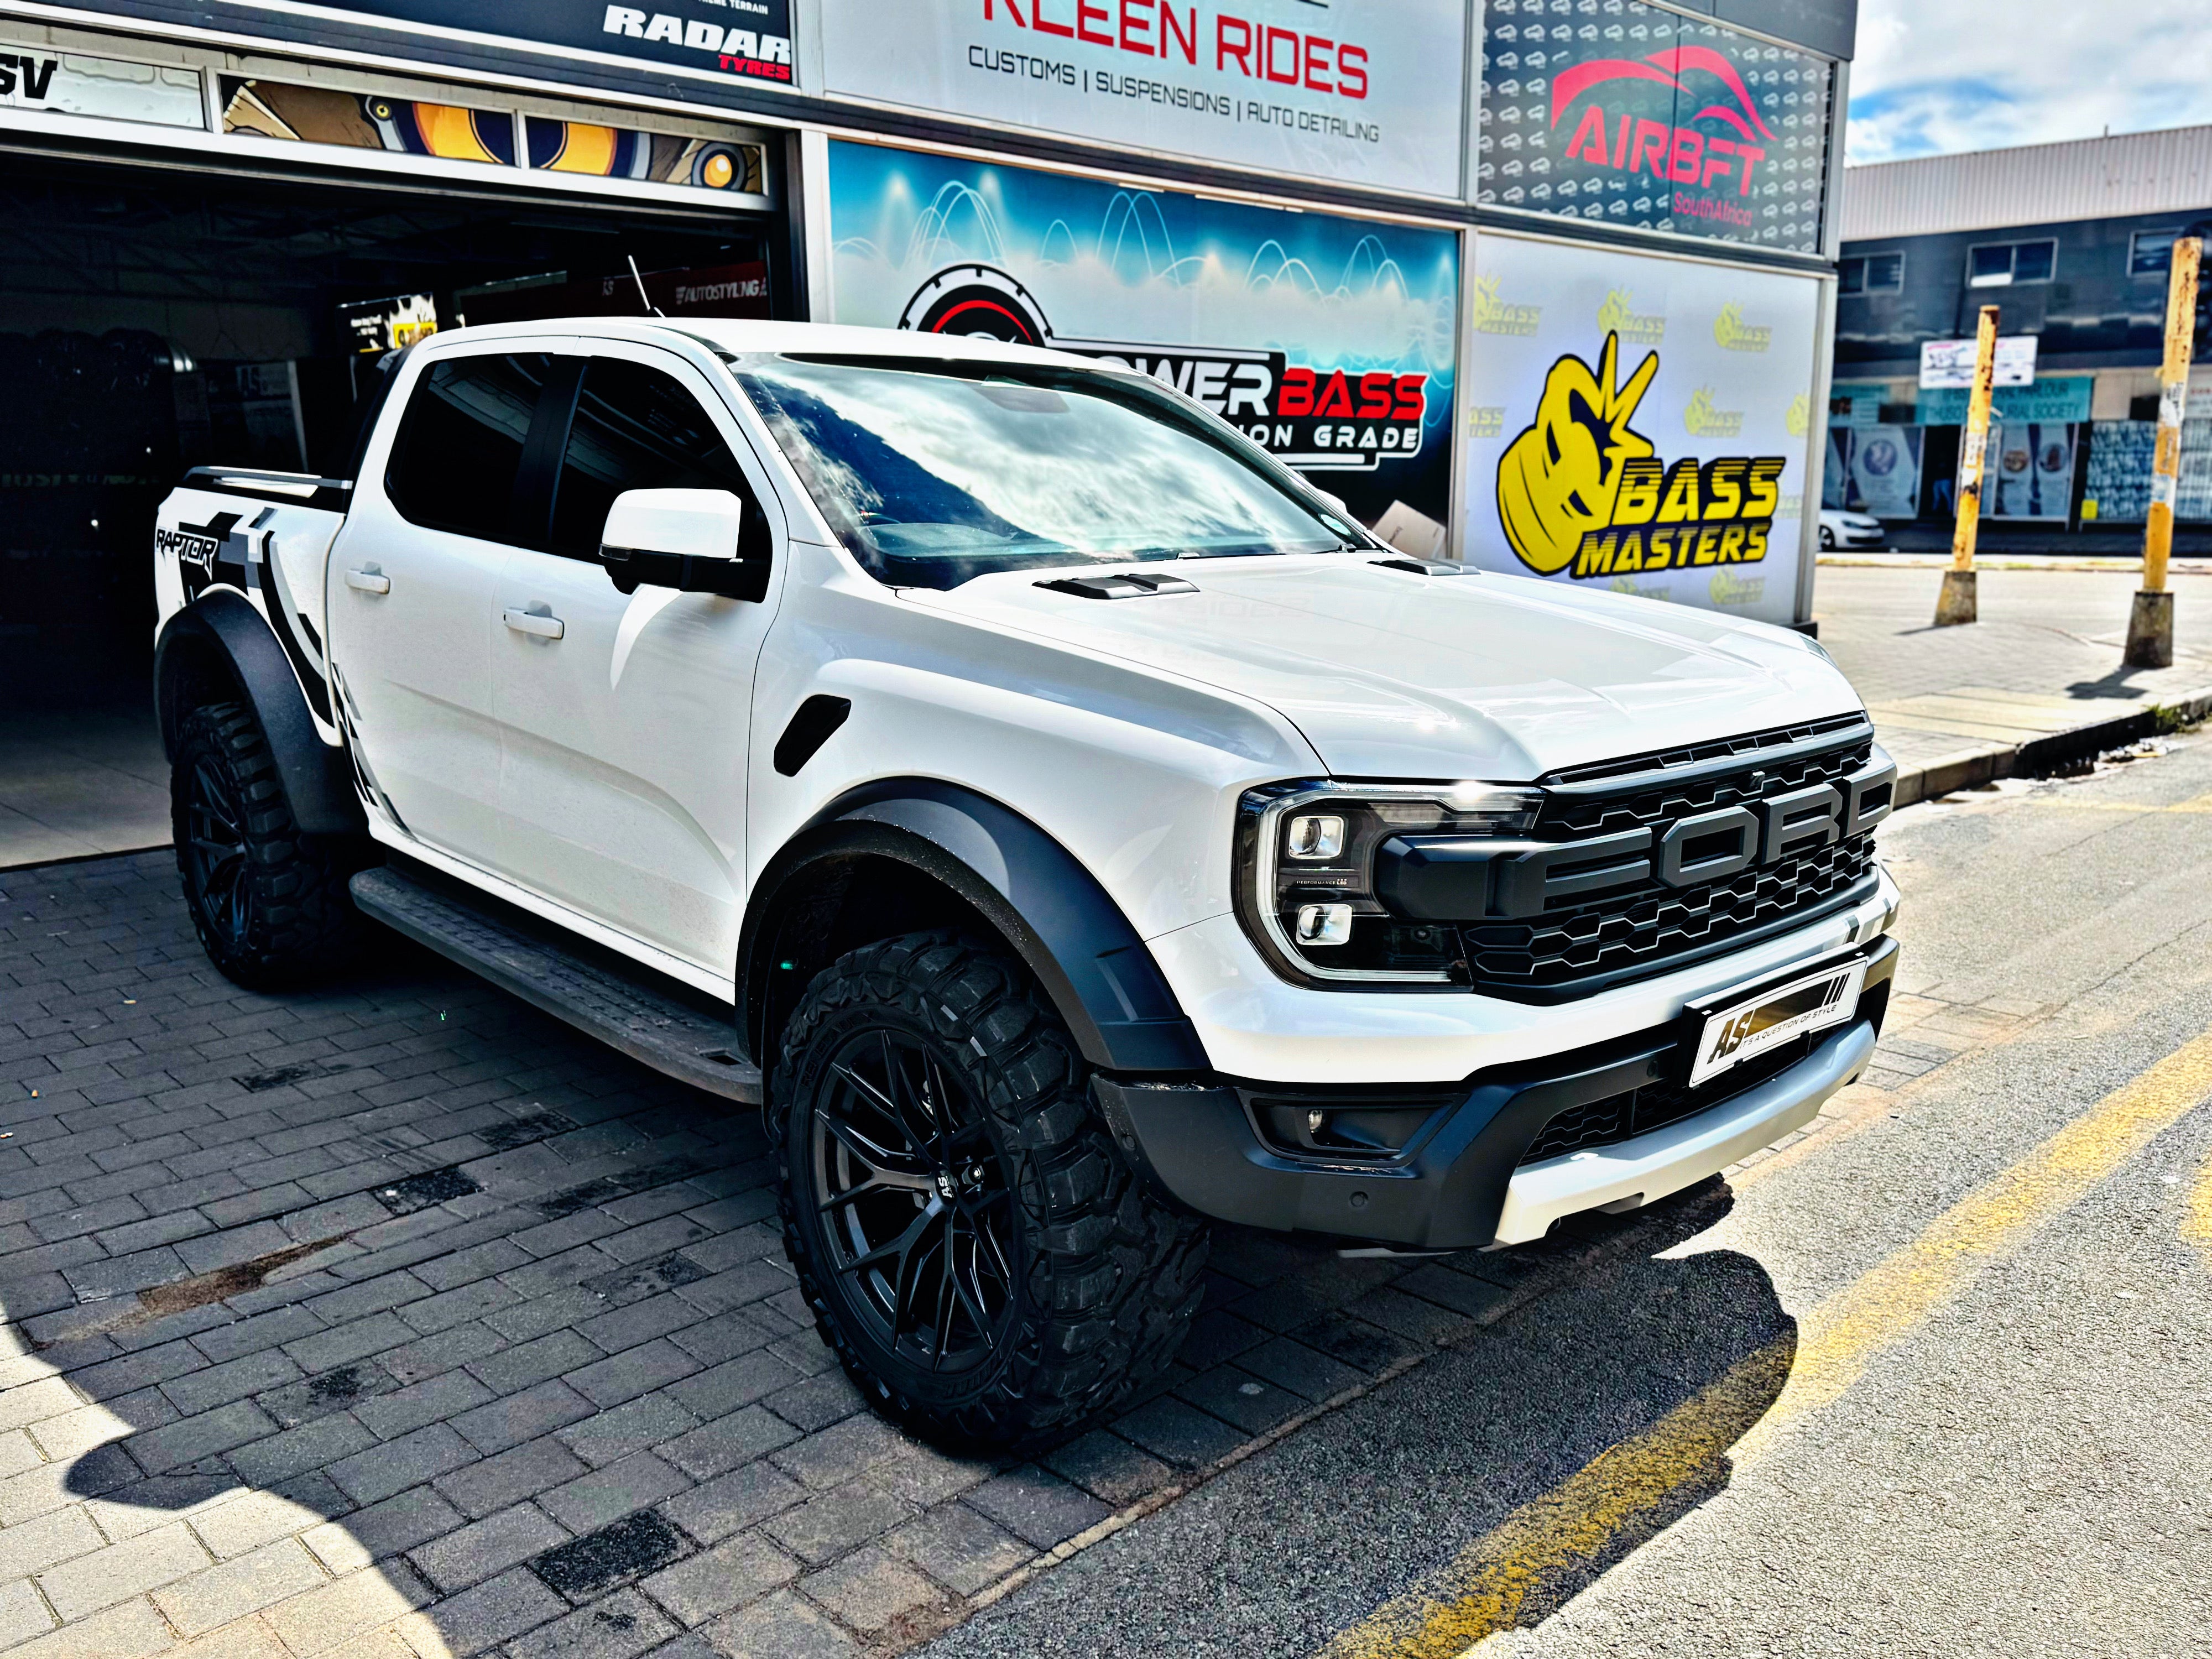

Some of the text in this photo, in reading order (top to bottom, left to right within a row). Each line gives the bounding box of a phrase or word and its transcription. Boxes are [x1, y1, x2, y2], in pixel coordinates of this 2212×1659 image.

[729, 0, 768, 15] TERRAIN
[603, 5, 791, 65] RADAR
[1217, 14, 1368, 100] RIDES
[718, 54, 790, 80] TYRES
[968, 45, 1076, 86] CUSTOMS
[1095, 71, 1230, 116] SUSPENSIONS
[1248, 101, 1294, 128] AUTO
[1298, 111, 1379, 143] DETAILING
[1565, 105, 1766, 197] AIRBFT
[1277, 368, 1428, 420] BASS
[1313, 425, 1418, 449] GRADE
[1611, 460, 1785, 525] BASS
[156, 528, 217, 581] RAPTOR
[1575, 522, 1770, 576] MASTERS
[1496, 764, 1896, 919] FORD
[1707, 1010, 1754, 1065] AS
[1762, 1018, 1799, 1040] QUESTION
[1800, 1015, 1811, 1023] OF
[1812, 1004, 1837, 1018] STYLE
[938, 1175, 952, 1198] AS
